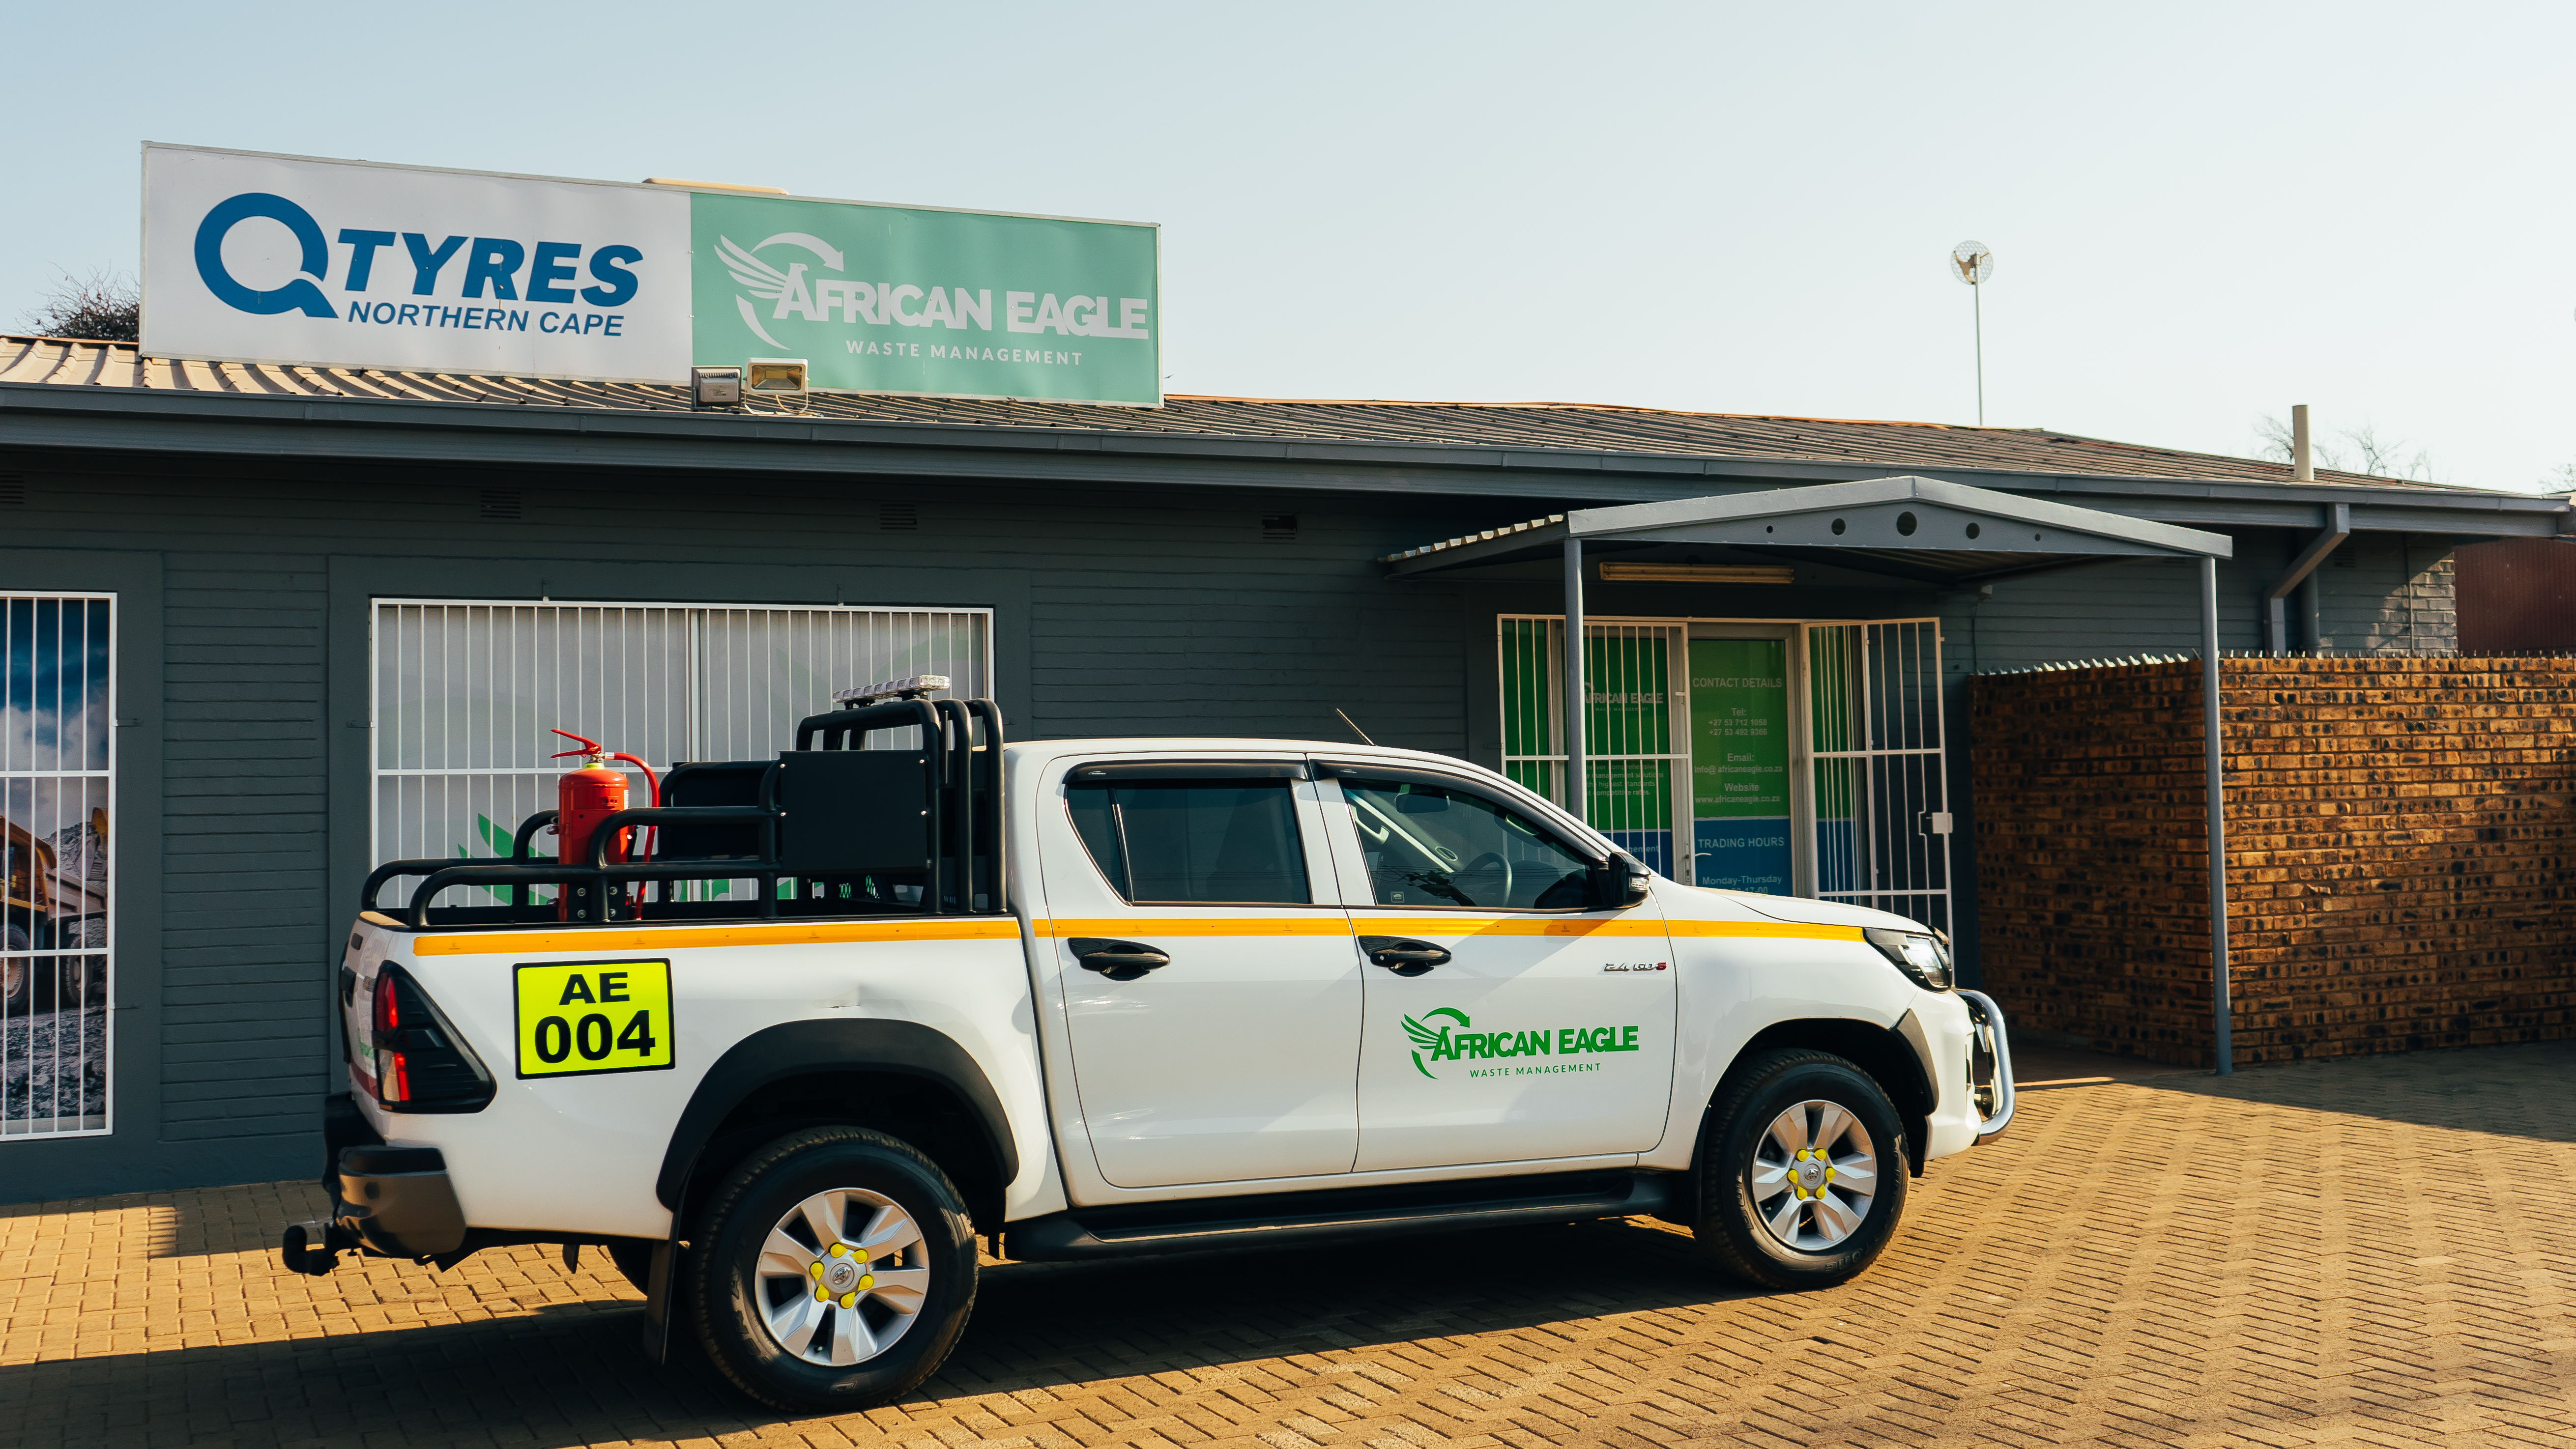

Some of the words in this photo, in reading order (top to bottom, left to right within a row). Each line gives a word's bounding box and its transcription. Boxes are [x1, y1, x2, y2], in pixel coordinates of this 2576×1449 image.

[773, 263, 992, 331] AFRICAN
[1007, 290, 1149, 340] EAGLE
[347, 301, 529, 333] NORTHERN
[539, 312, 624, 337] CAPE
[845, 340, 920, 357] WASTE
[930, 344, 1083, 366] MANAGEMENT
[1692, 678, 1739, 687] CONTACT
[1742, 678, 1782, 687] DETAILS
[1731, 708, 1746, 716] Tel:
[1727, 753, 1754, 762] Email:
[1724, 783, 1760, 792] Website
[1698, 838, 1744, 848] TRADING
[1748, 837, 1785, 847] HOURS
[1703, 875, 1782, 886] Monday-Thursday
[558, 972, 630, 1005] AE
[535, 1010, 656, 1064] 004
[1430, 1026, 1550, 1061] AFRICAN
[1558, 1025, 1639, 1054] EAGLE
[1470, 1068, 1509, 1079] WASTE
[1516, 1063, 1601, 1076] MANAGEMENT
